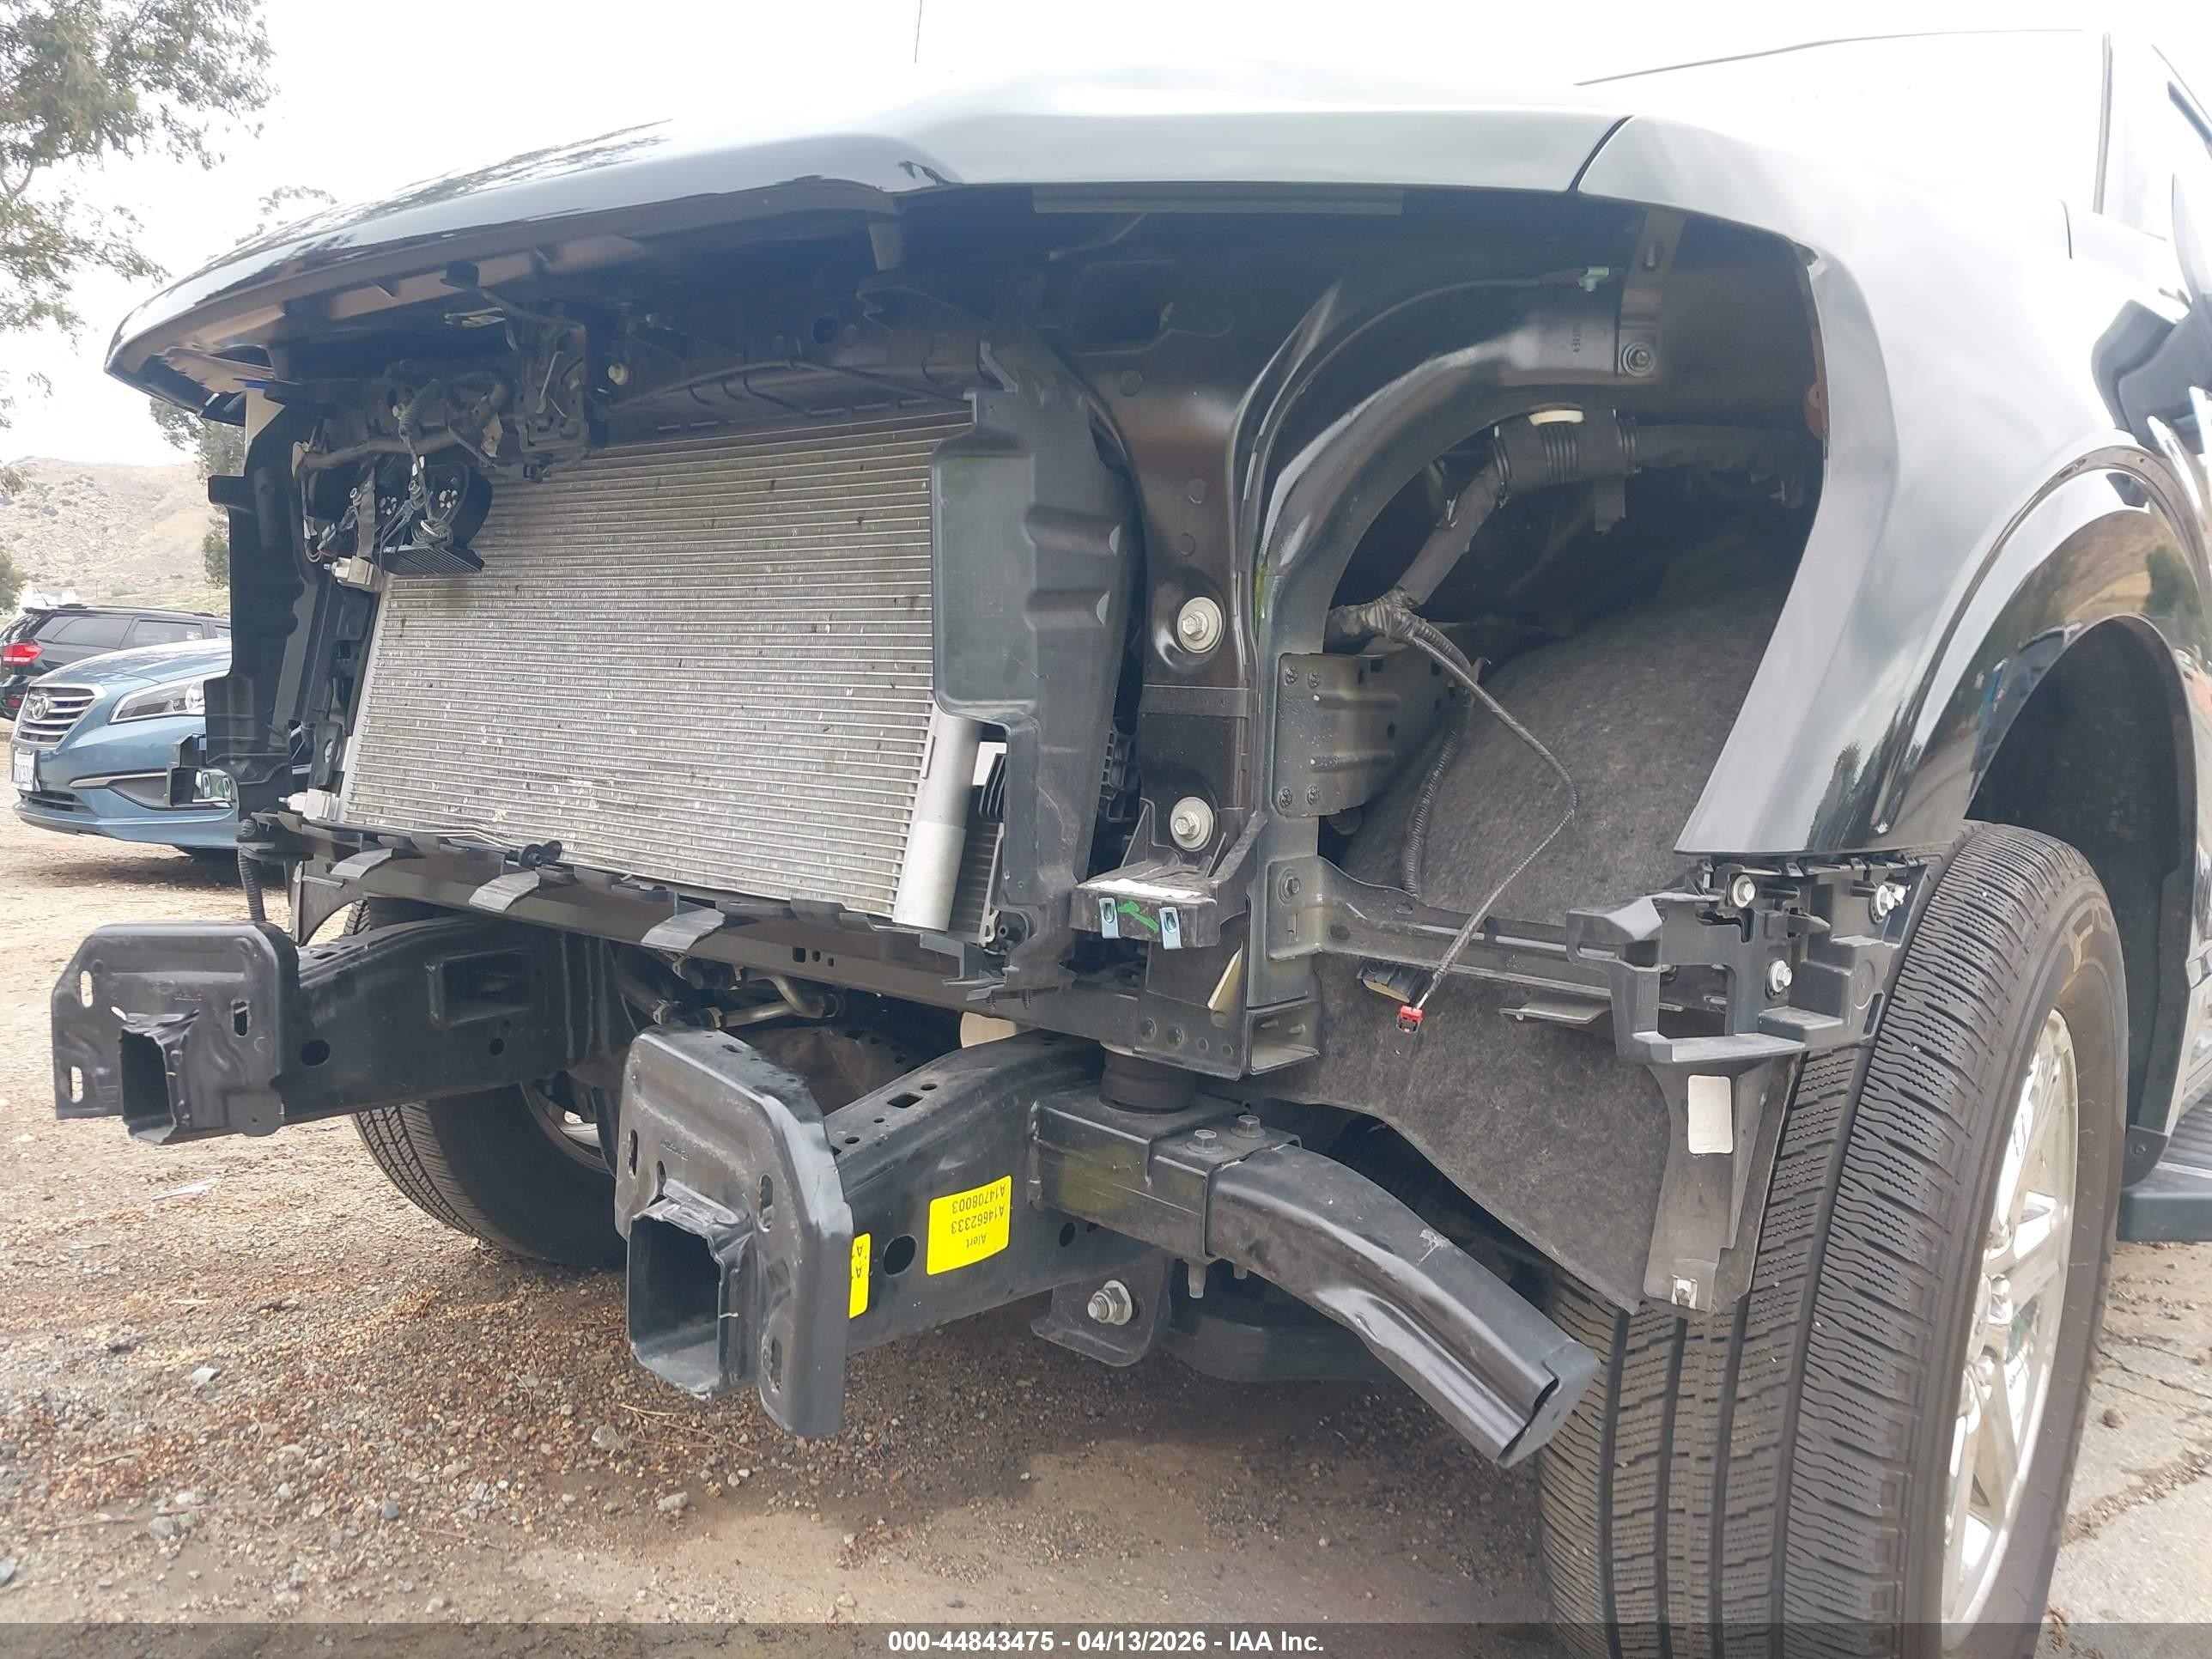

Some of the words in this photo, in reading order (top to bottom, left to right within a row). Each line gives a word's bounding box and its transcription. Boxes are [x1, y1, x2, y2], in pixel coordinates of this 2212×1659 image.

[952, 1184, 1006, 1213] A14708003
[951, 1204, 1005, 1234] A14662333
[966, 1232, 987, 1248] Alert
